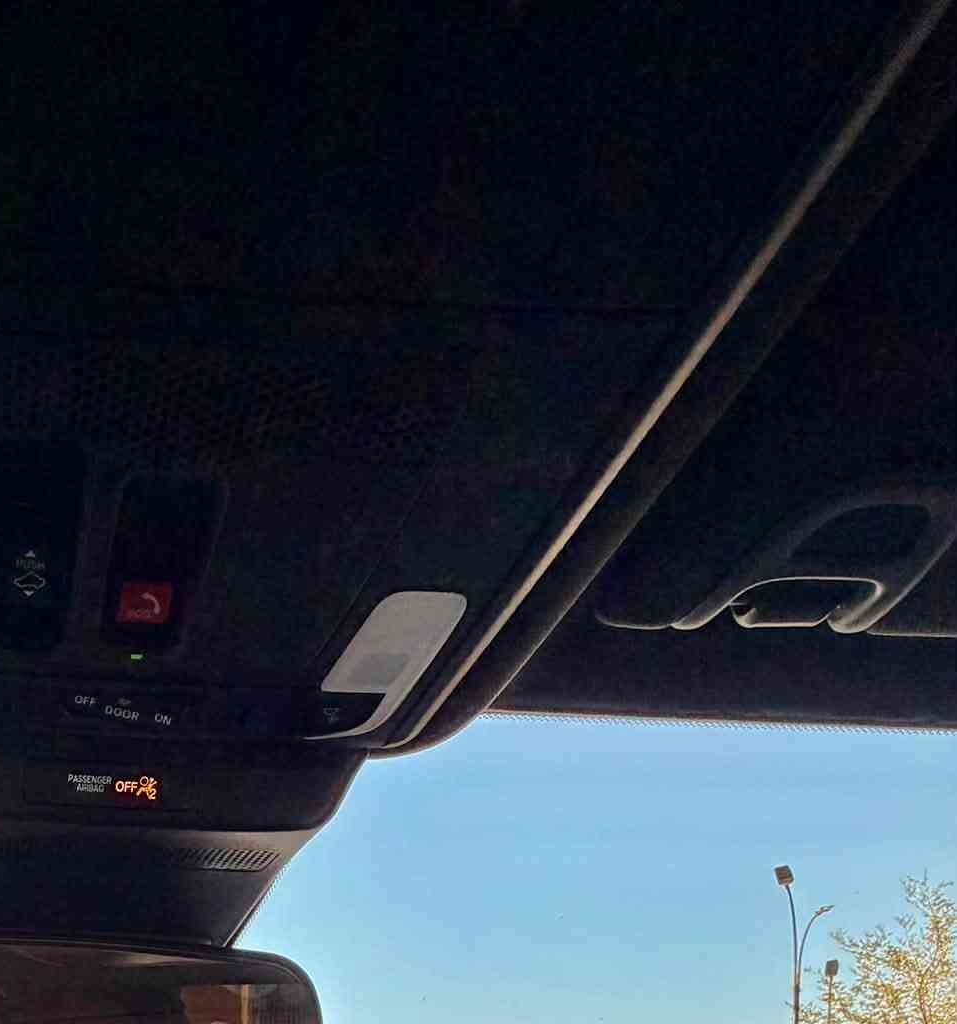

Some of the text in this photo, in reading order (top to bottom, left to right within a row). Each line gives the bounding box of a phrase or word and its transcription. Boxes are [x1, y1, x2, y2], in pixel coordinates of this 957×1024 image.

[74, 695, 96, 705] OFF
[104, 705, 140, 720] DOOR
[154, 713, 172, 725] ON
[67, 774, 112, 785] PASSENGER
[76, 783, 105, 793] AIRBAG
[115, 780, 138, 793] OFF
